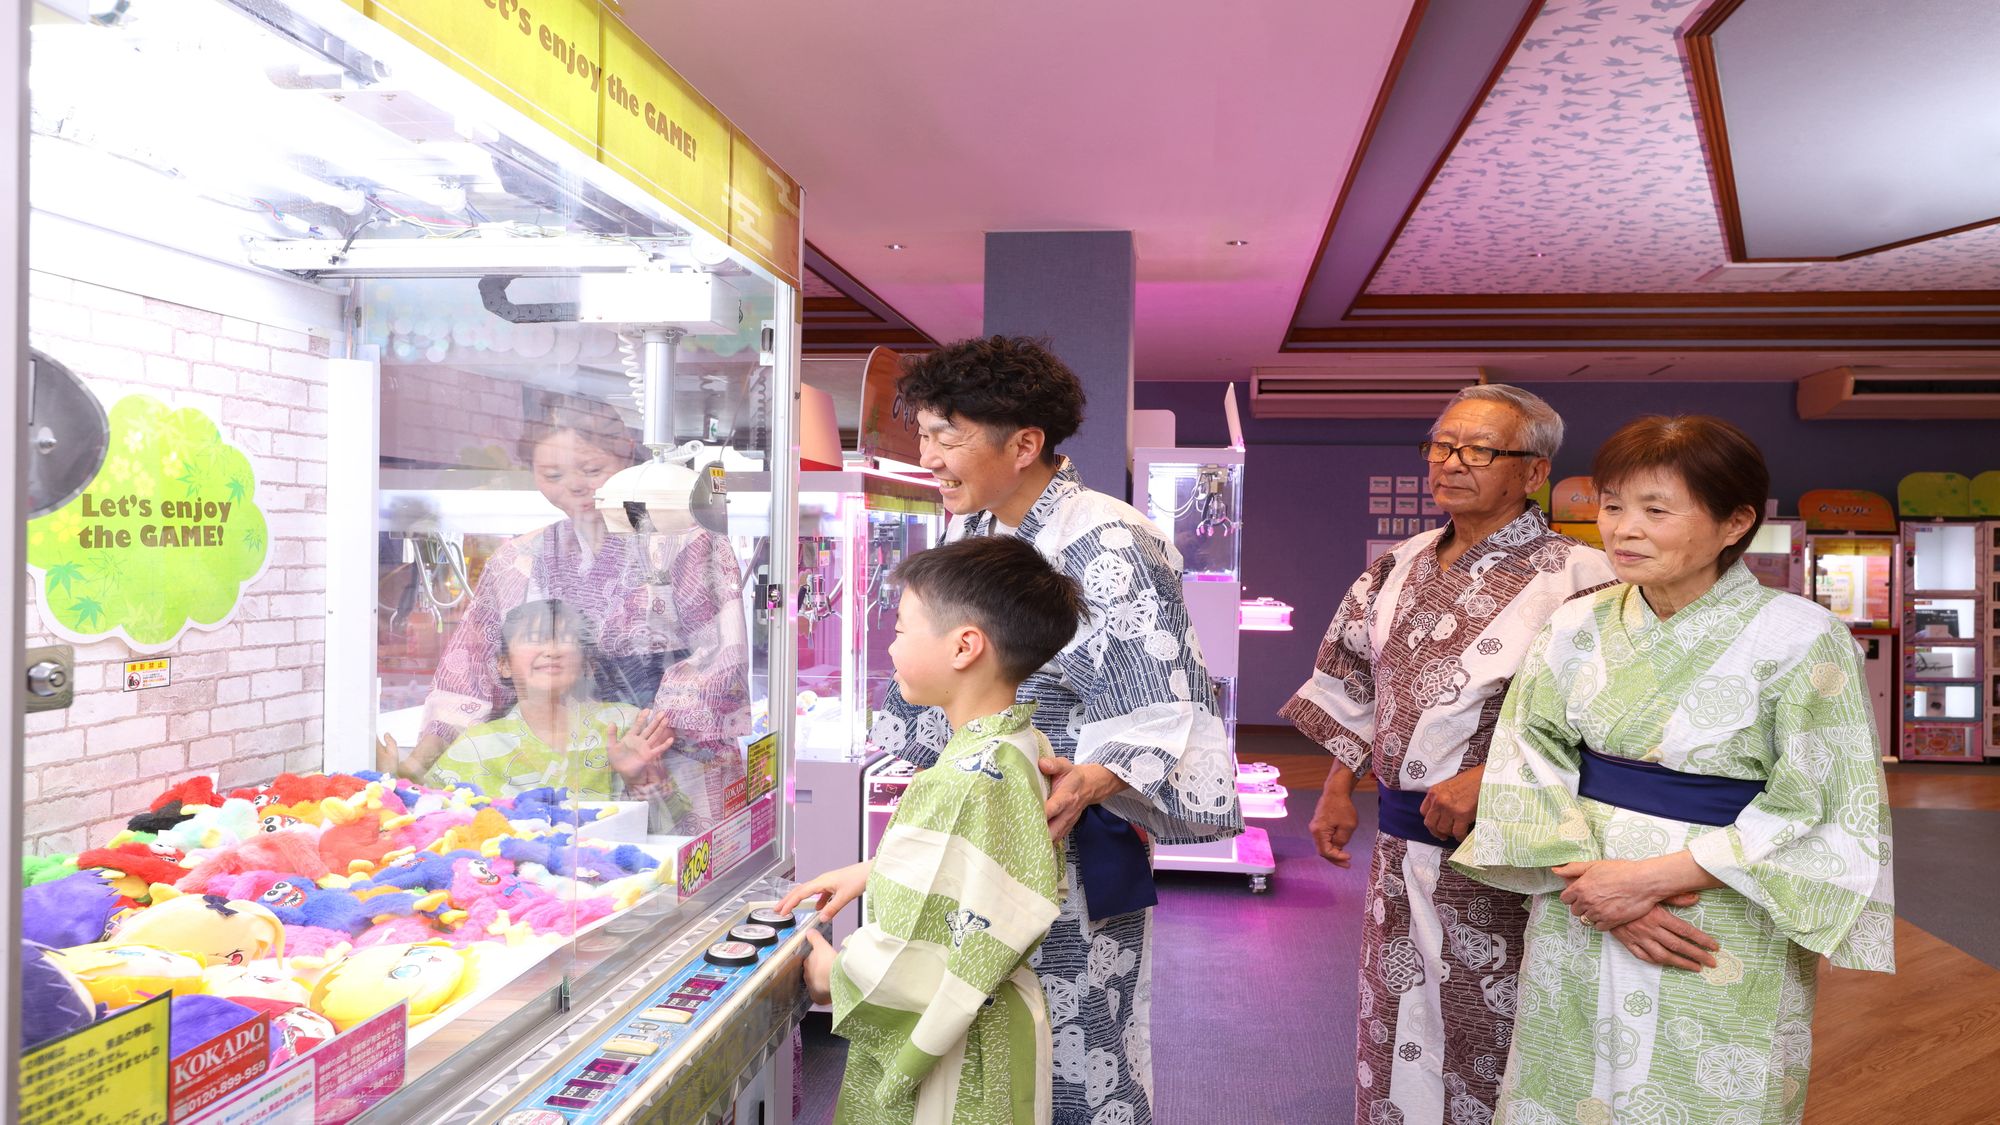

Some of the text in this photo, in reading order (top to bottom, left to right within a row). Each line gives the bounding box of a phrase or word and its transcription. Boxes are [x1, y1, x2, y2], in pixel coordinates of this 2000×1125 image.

[538, 24, 602, 93] enjoy
[606, 73, 640, 117] the
[644, 102, 697, 162] GAME!
[82, 493, 232, 523] Let's enjoy
[77, 525, 224, 549] the GAME!
[174, 1022, 265, 1086] KOKADO
